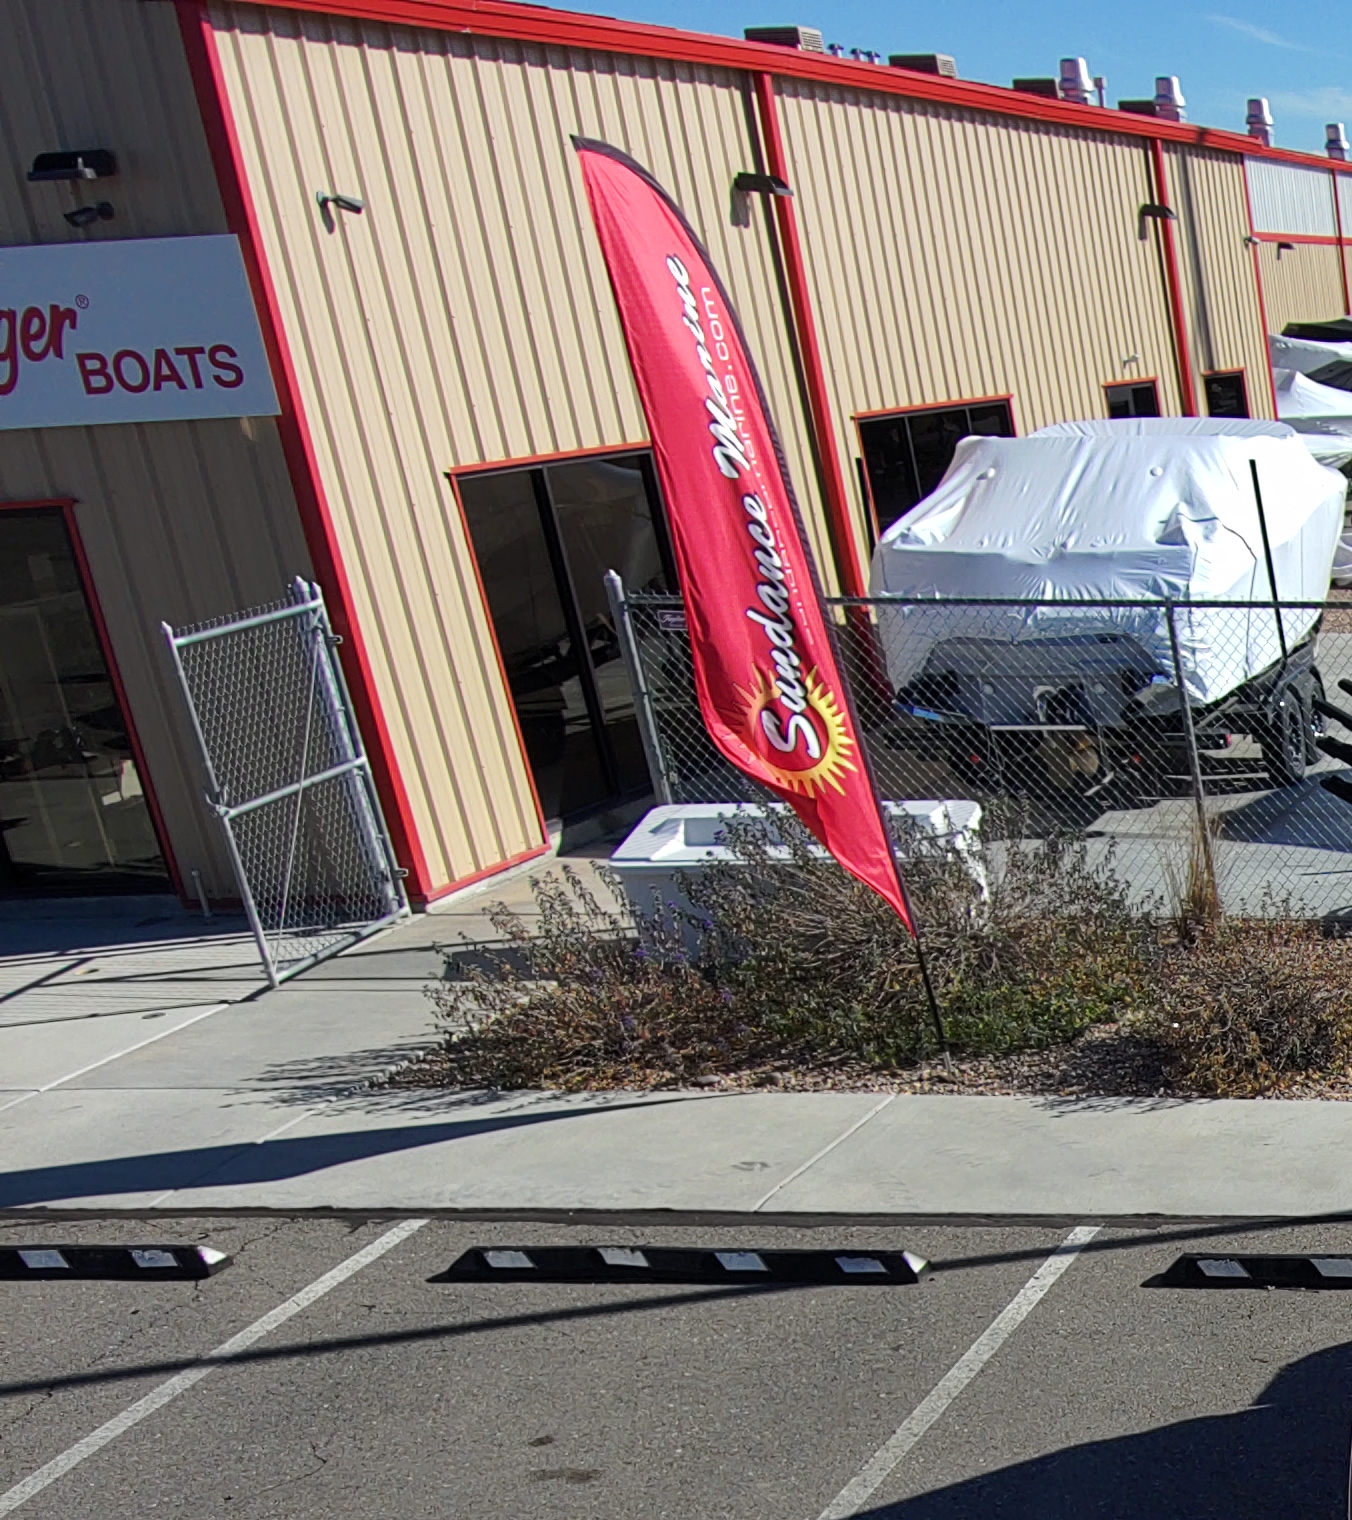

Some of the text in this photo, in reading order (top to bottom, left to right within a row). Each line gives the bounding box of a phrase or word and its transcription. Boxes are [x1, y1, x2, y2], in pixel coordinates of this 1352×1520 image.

[75, 344, 244, 395] BOATS
[666, 254, 821, 760] Sundance Marine
